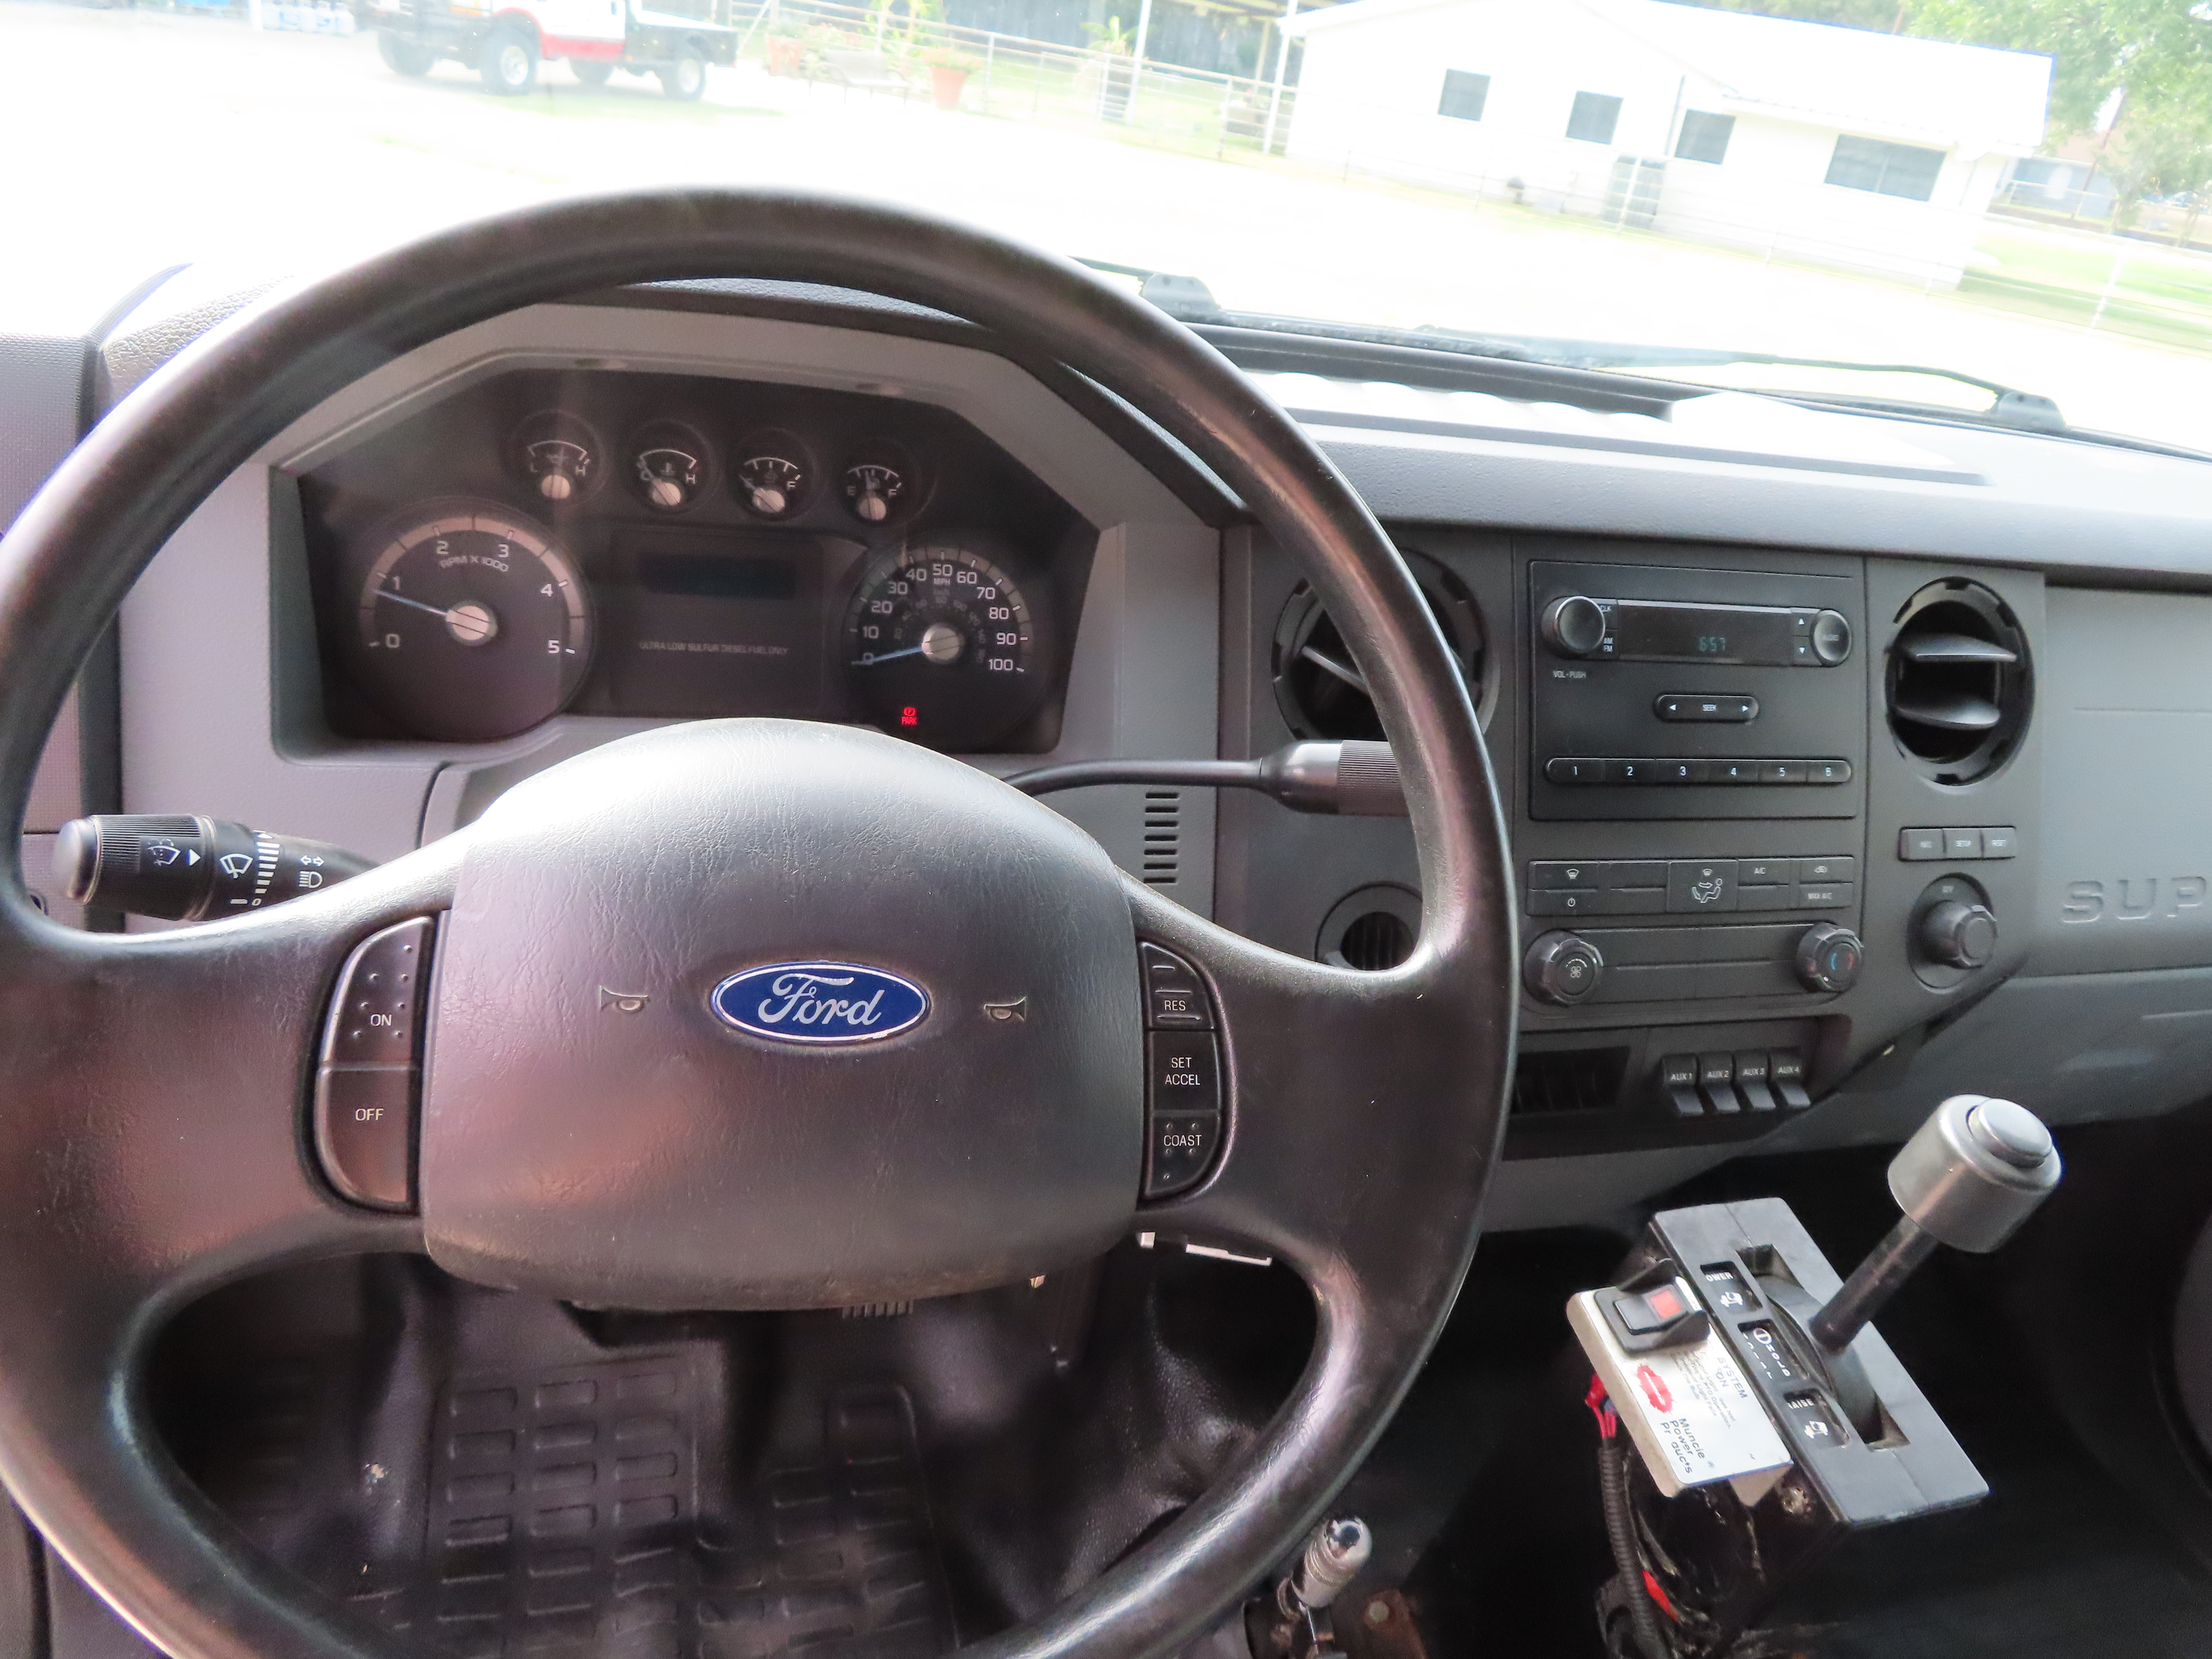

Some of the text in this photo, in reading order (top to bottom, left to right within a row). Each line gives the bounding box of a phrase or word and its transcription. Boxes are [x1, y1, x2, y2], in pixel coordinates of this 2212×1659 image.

[575, 465, 586, 477] H
[685, 473, 696, 485] H
[786, 480, 796, 490] F
[888, 488, 897, 498] F
[436, 541, 449, 555] 2
[498, 543, 509, 558] 3
[906, 568, 927, 582] 40
[933, 564, 953, 577] 50
[392, 576, 401, 591] 1
[956, 571, 978, 585] 60
[540, 583, 554, 597] 4
[888, 581, 908, 595] 30
[976, 586, 996, 600] 70
[871, 601, 894, 615] 20
[989, 607, 1010, 620] 80
[862, 626, 879, 639] 10
[996, 632, 1017, 646] 90
[385, 633, 400, 649] 0
[548, 640, 560, 654] 5
[863, 652, 874, 666] 0
[988, 658, 1013, 672] 100
[901, 716, 918, 725] PARK
[1573, 766, 1578, 776] 1
[1627, 766, 1633, 776] 2
[1679, 766, 1687, 777] 3
[1730, 766, 1737, 776] 4
[757, 972, 885, 1026] Ford
[1164, 1000, 1186, 1011] RES
[370, 1013, 393, 1027] ON
[1171, 1057, 1192, 1069] SET
[1164, 1074, 1201, 1086] ACCEL
[1671, 1073, 1688, 1081] AUX
[1724, 1070, 1729, 1078] 2
[355, 1108, 384, 1121] OFF
[1163, 1135, 1202, 1147] COAST
[1706, 1271, 1734, 1282] OWER
[1716, 1357, 1749, 1398] SYSTEM
[1716, 1371, 1729, 1388] ON
[1703, 1381, 1713, 1395] PTO
[1727, 1410, 1736, 1421] Not
[1669, 1420, 1694, 1455] Power
[1678, 1417, 1705, 1459] Muncie
[1660, 1422, 1693, 1474] Prducts
